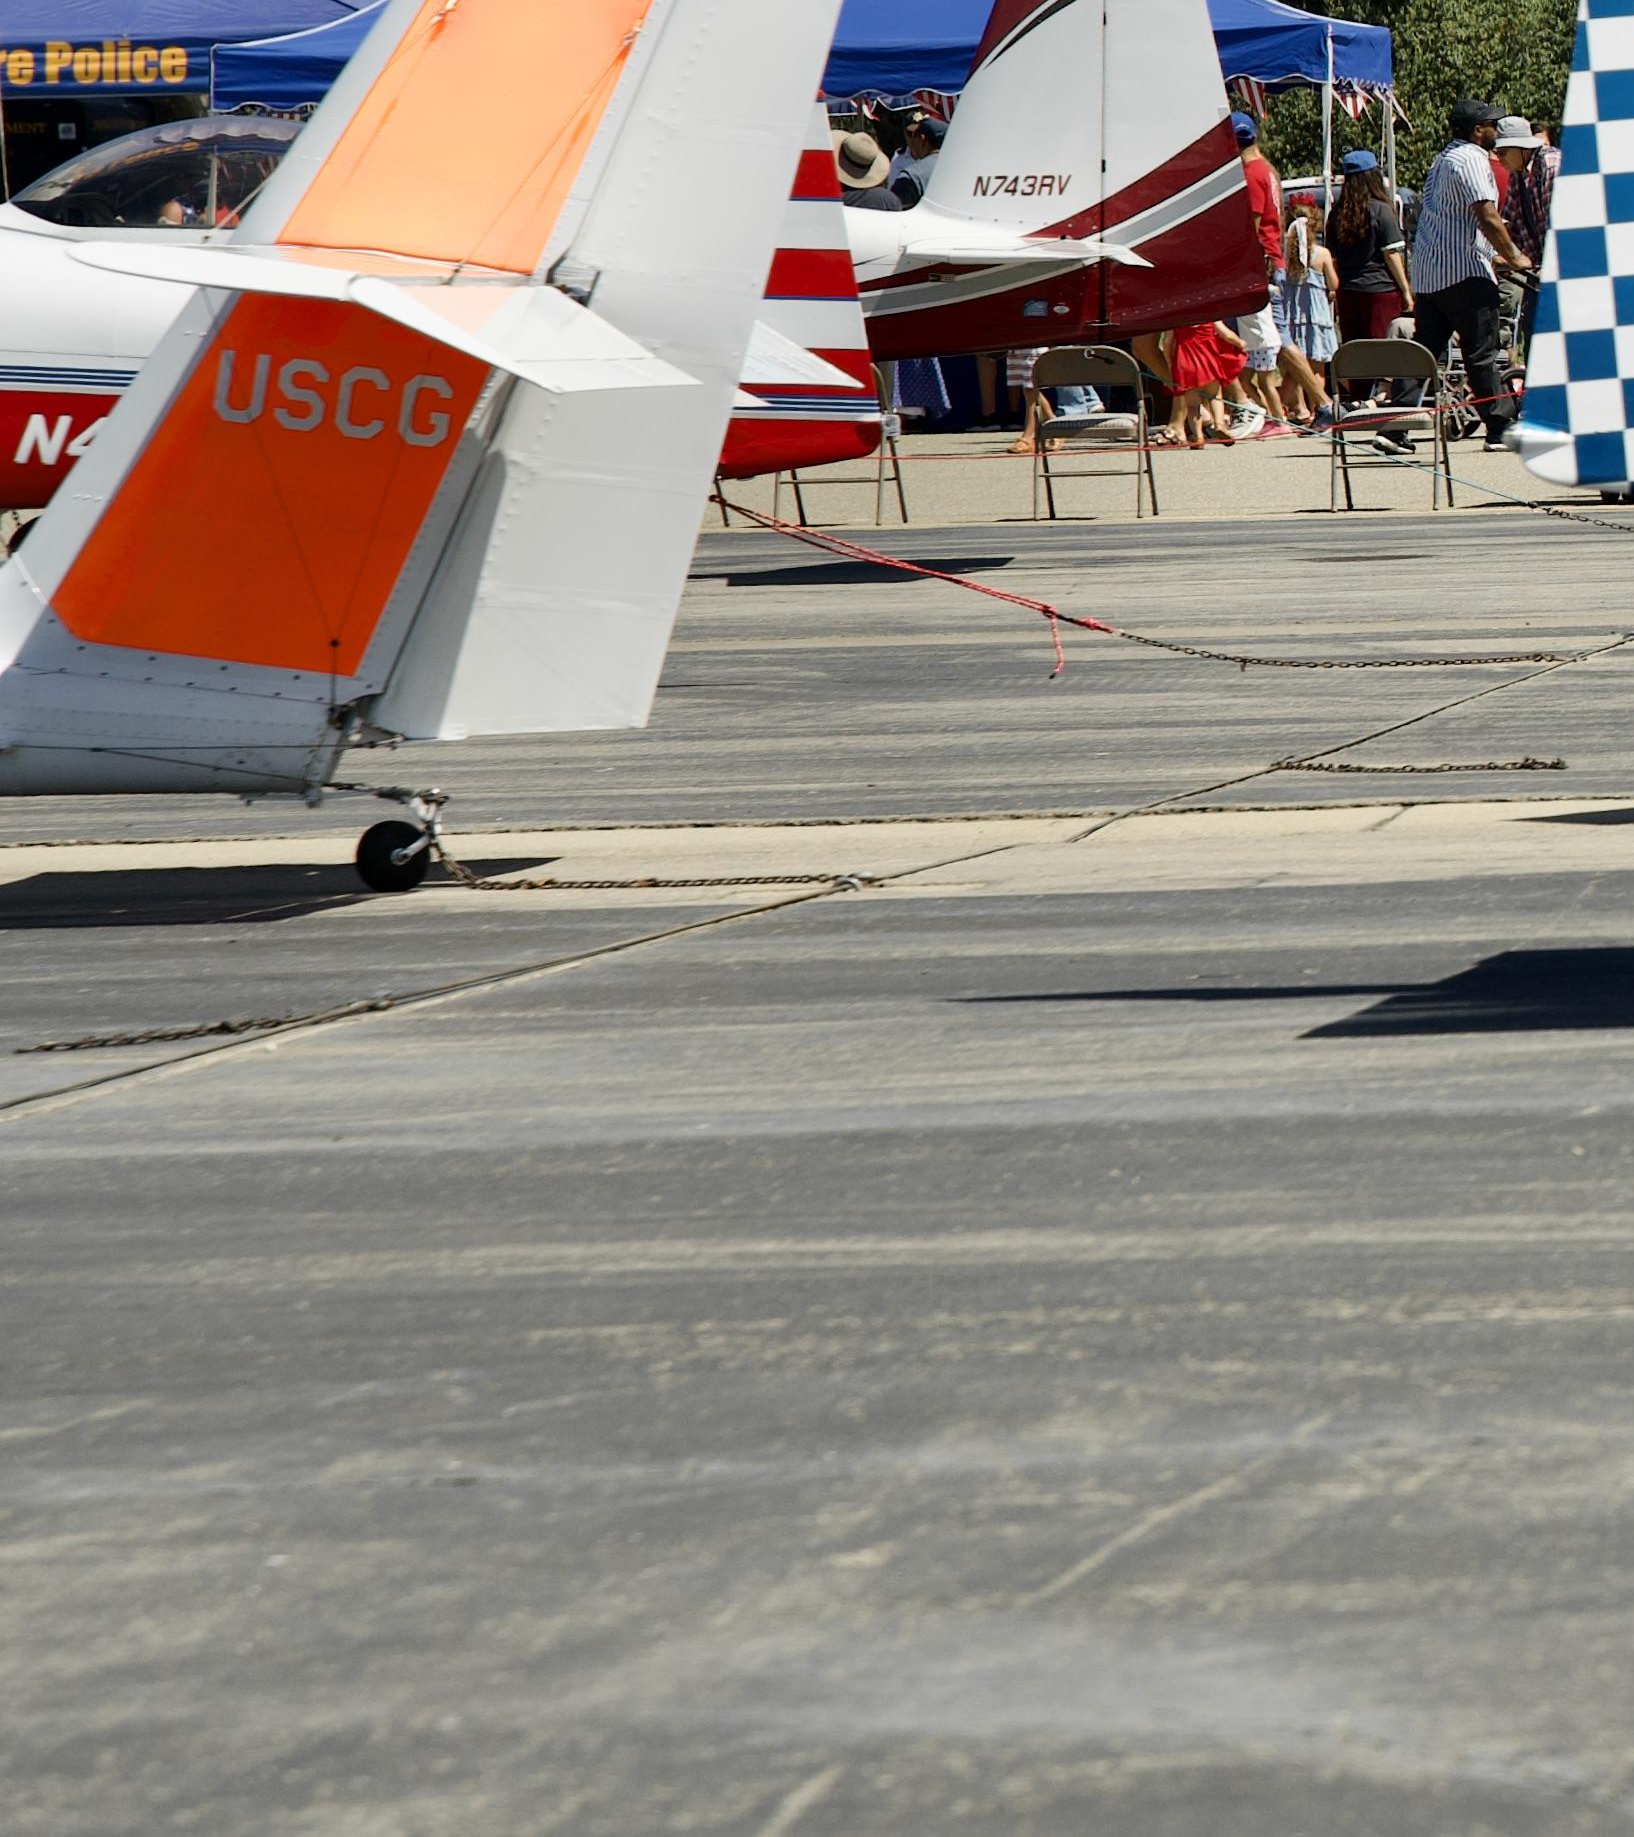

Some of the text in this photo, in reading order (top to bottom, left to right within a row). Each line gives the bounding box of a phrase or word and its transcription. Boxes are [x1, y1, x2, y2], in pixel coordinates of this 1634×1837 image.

[46, 41, 188, 84] Police
[973, 174, 1072, 196] N743RV
[213, 349, 454, 448] USCG
